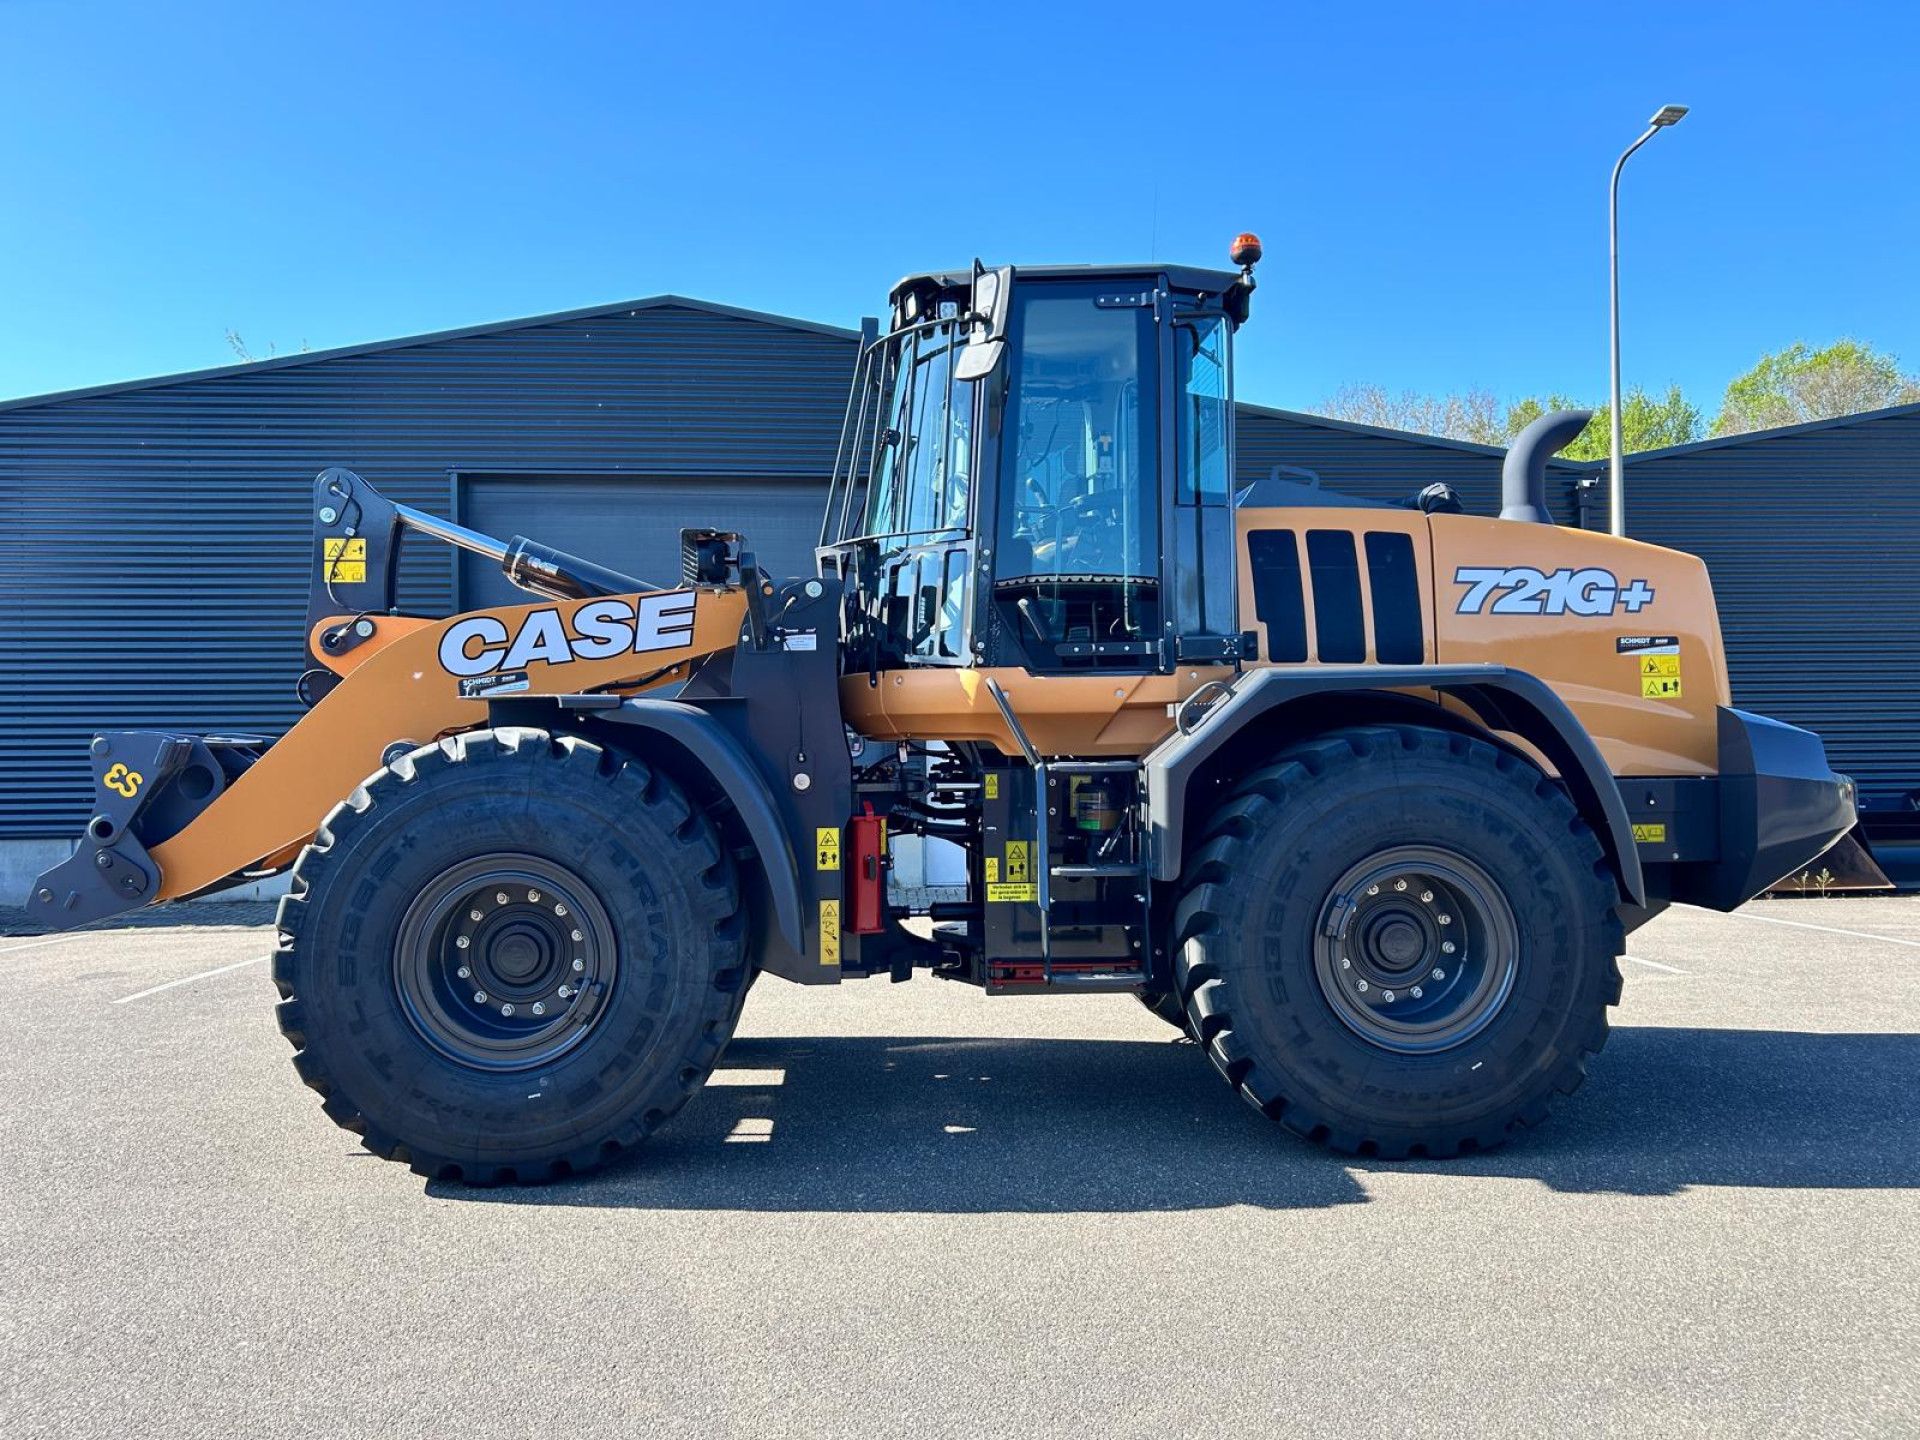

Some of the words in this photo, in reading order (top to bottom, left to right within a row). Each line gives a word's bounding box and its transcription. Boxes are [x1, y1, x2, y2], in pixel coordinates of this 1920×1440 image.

[1453, 566, 1655, 617] 721G+
[438, 591, 697, 677] CASE
[462, 676, 496, 686] SCHMIDT
